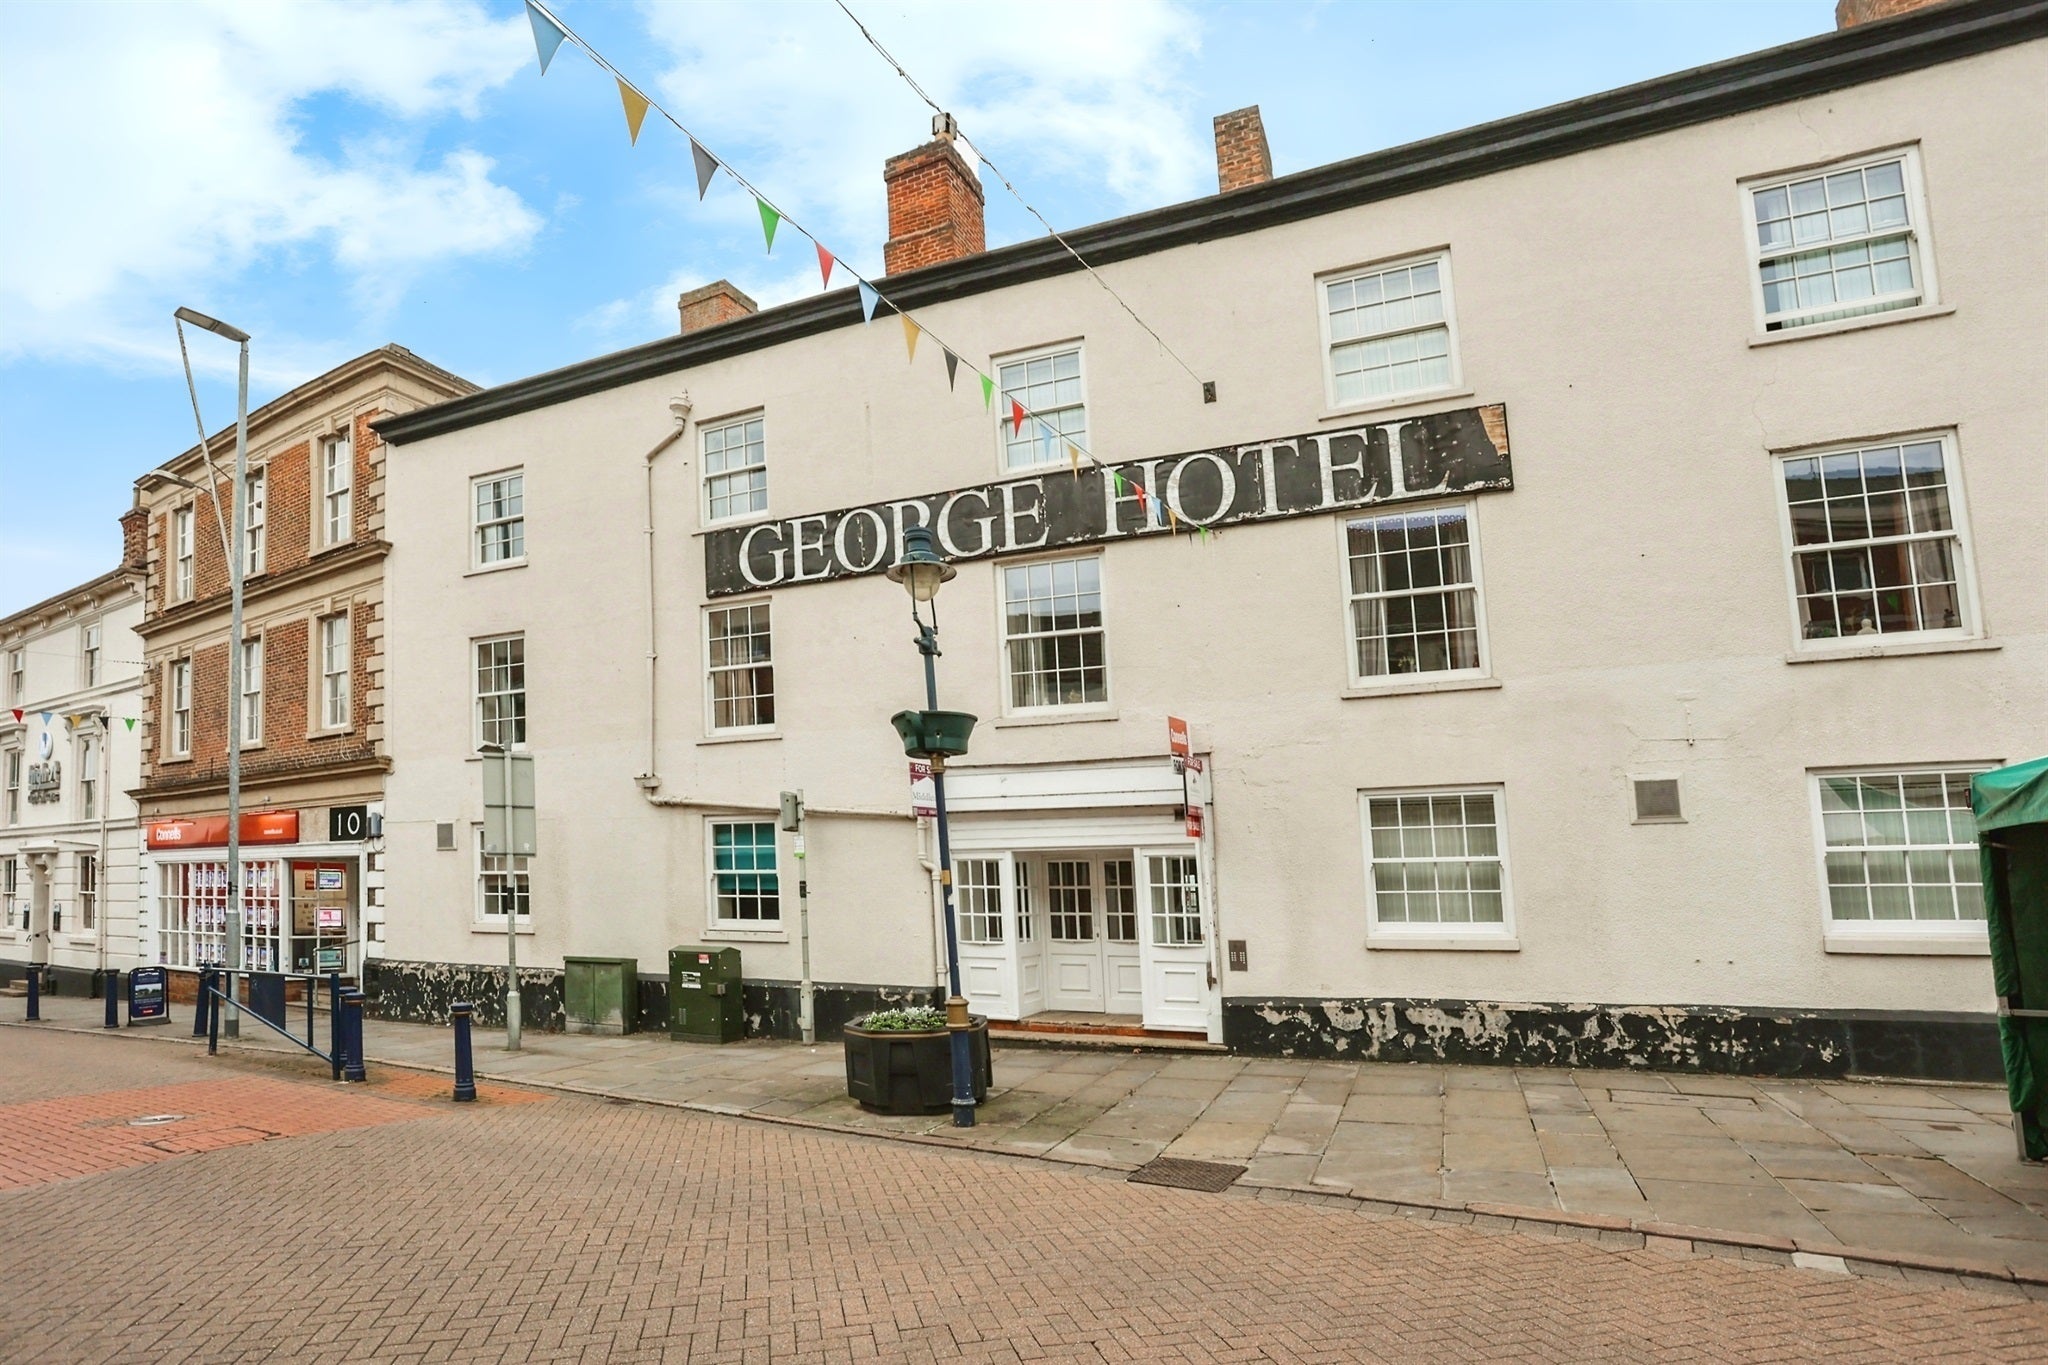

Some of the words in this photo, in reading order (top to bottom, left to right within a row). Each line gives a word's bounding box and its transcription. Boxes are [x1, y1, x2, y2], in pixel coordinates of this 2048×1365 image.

[738, 477, 1050, 587] GEORGE
[1100, 420, 1450, 538] HOTEL
[915, 764, 926, 773] FOR
[337, 811, 360, 836] 10
[156, 827, 182, 841] Connells
